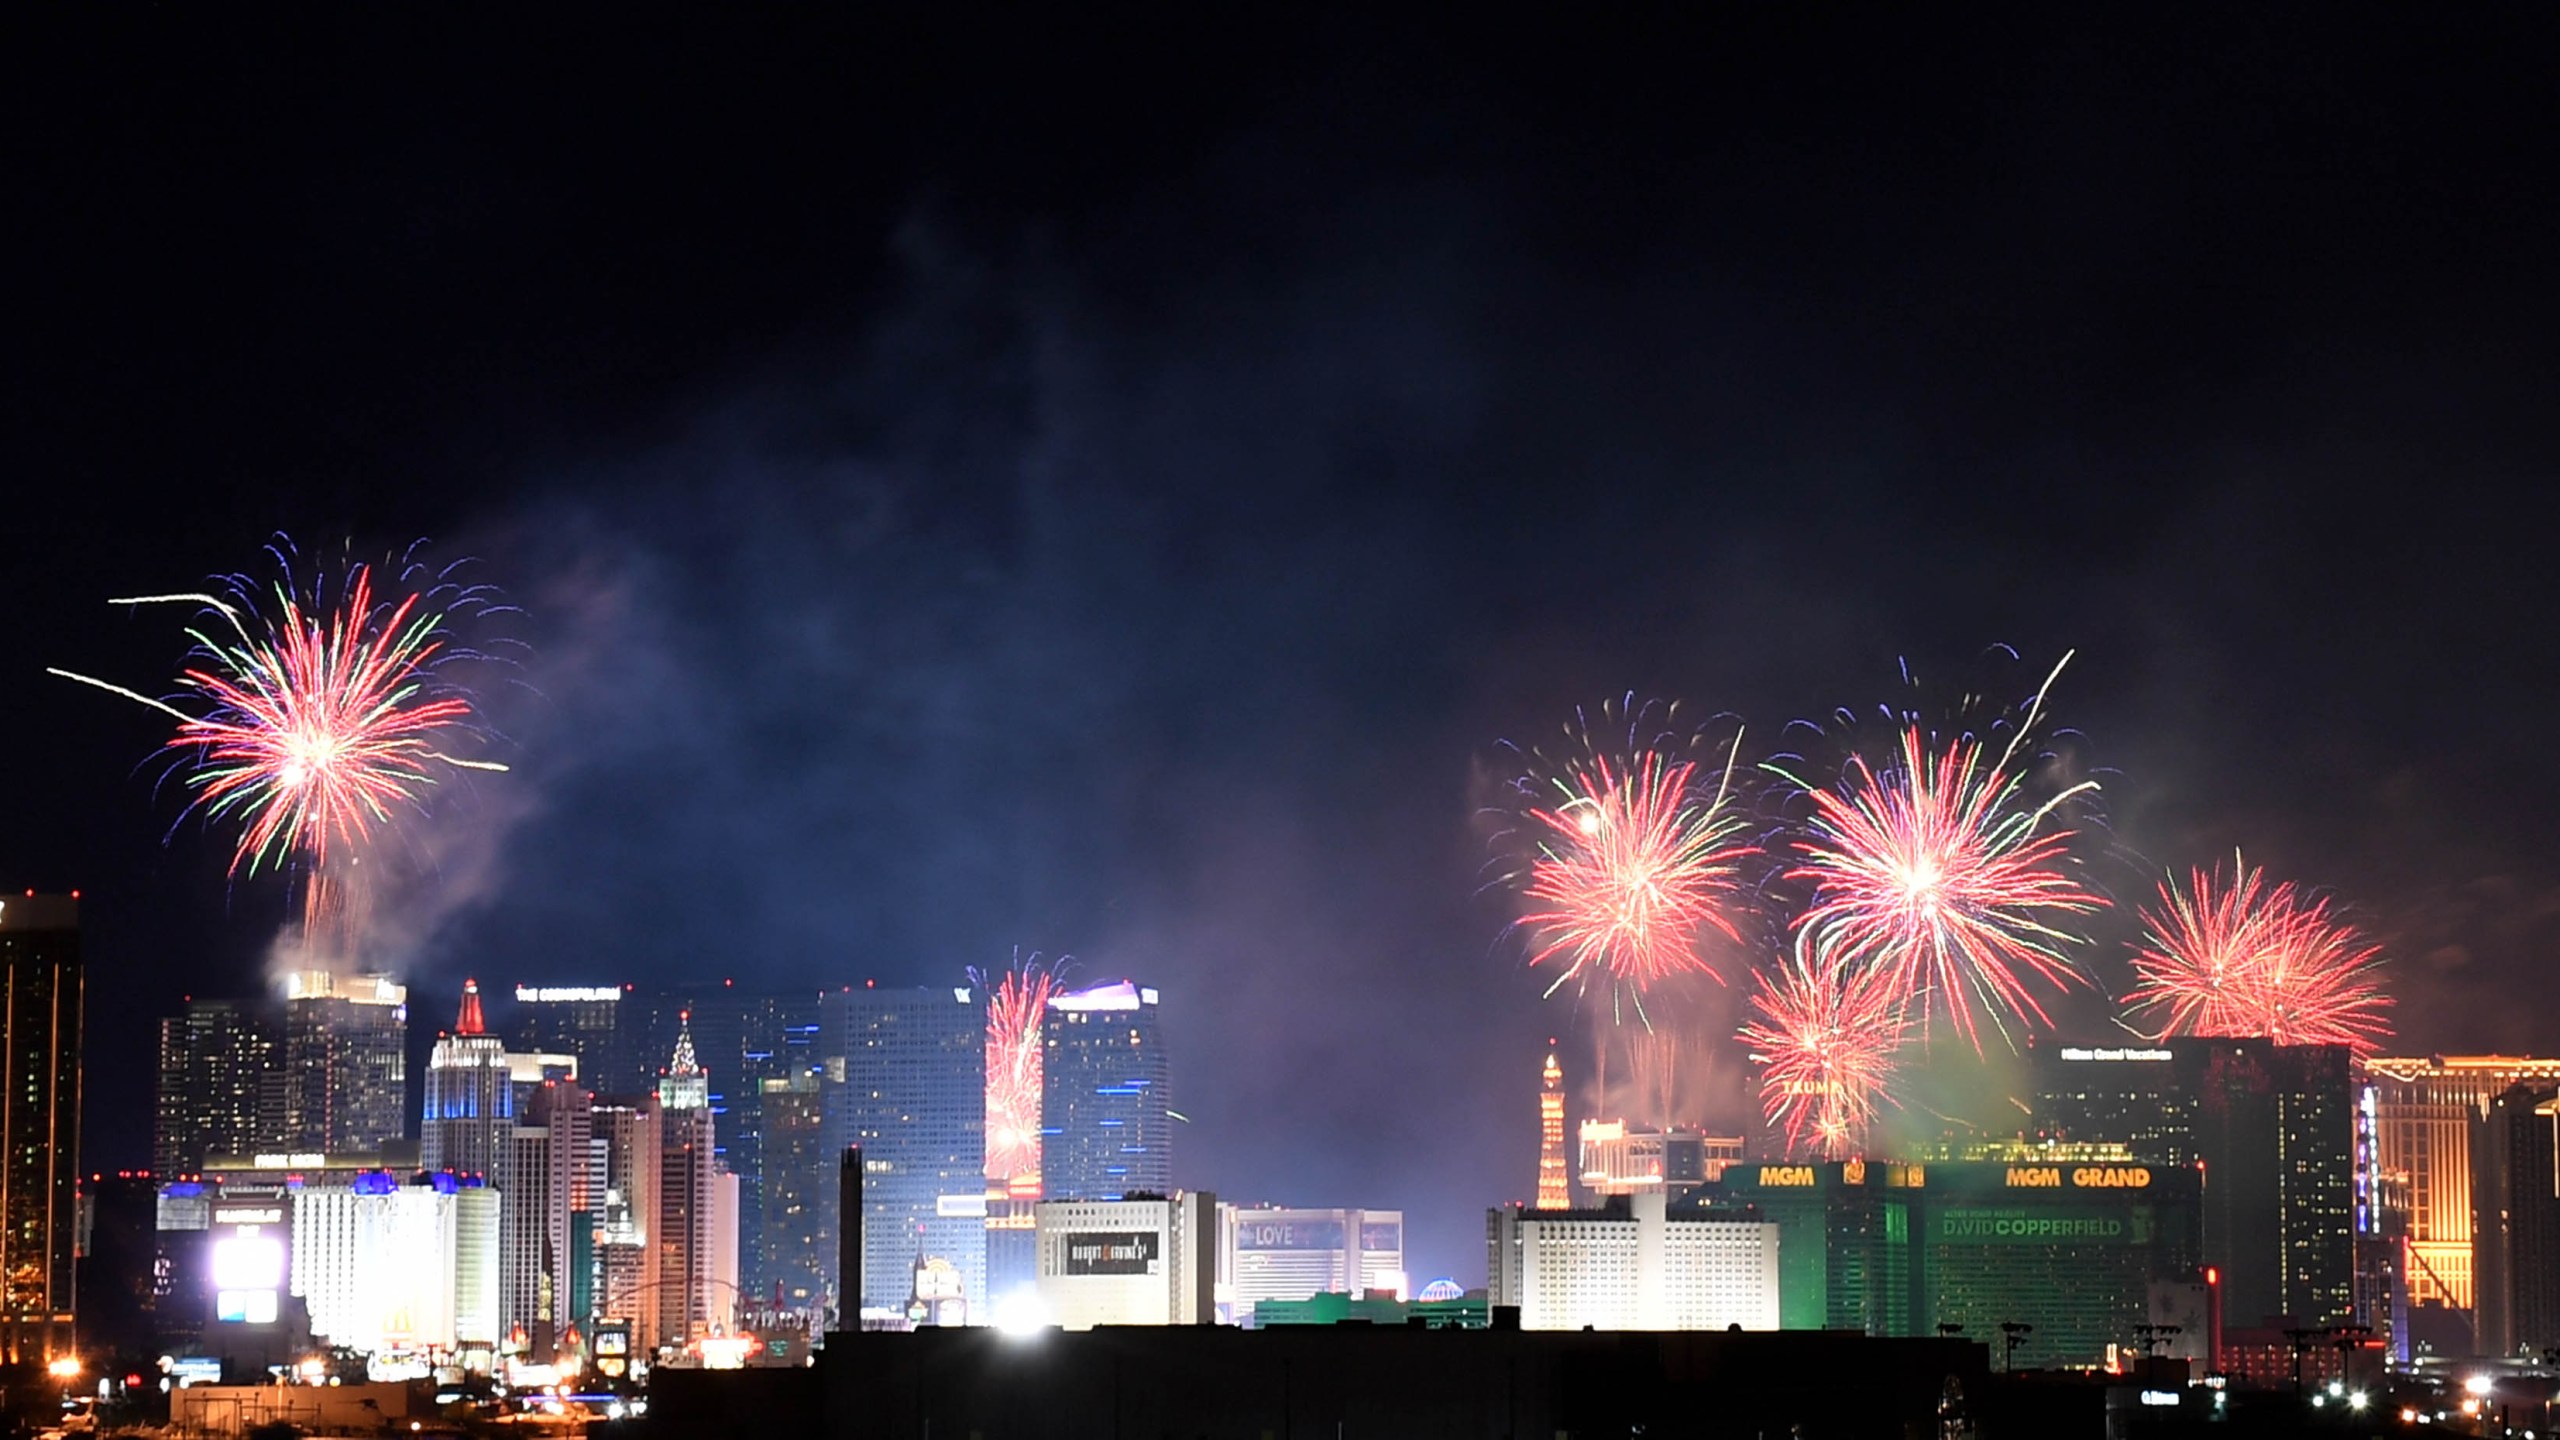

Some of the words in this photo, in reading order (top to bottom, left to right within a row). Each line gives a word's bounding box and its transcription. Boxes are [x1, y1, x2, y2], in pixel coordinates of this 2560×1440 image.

[1759, 1167, 1815, 1186] MGM
[2006, 1168, 2061, 1187] MGM
[2072, 1168, 2150, 1187] GRAND
[1256, 1226, 1293, 1245] LOVE
